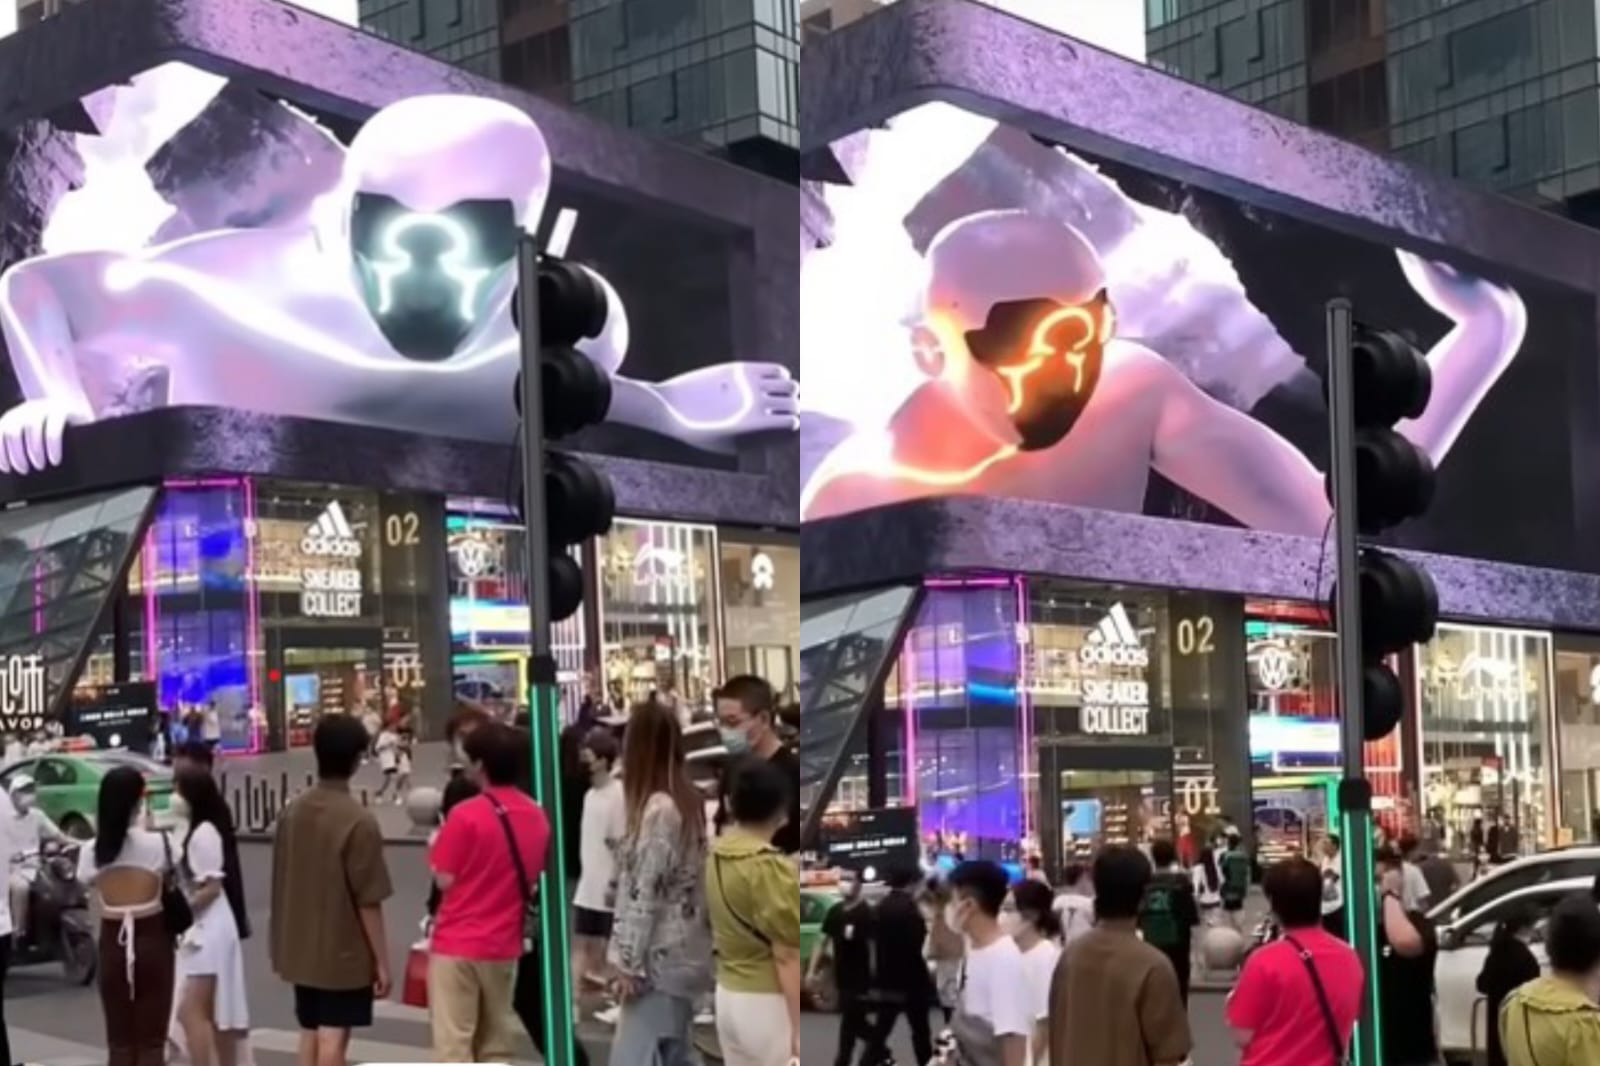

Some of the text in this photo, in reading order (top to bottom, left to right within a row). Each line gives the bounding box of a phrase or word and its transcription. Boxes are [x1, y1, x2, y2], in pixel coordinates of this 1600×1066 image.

[386, 511, 420, 546] 02
[302, 591, 361, 617] COLLECT
[1177, 615, 1215, 655] 02
[1081, 642, 1149, 668] adidas
[1082, 679, 1149, 705] SNEAKER
[1081, 705, 1149, 735] COLLECT
